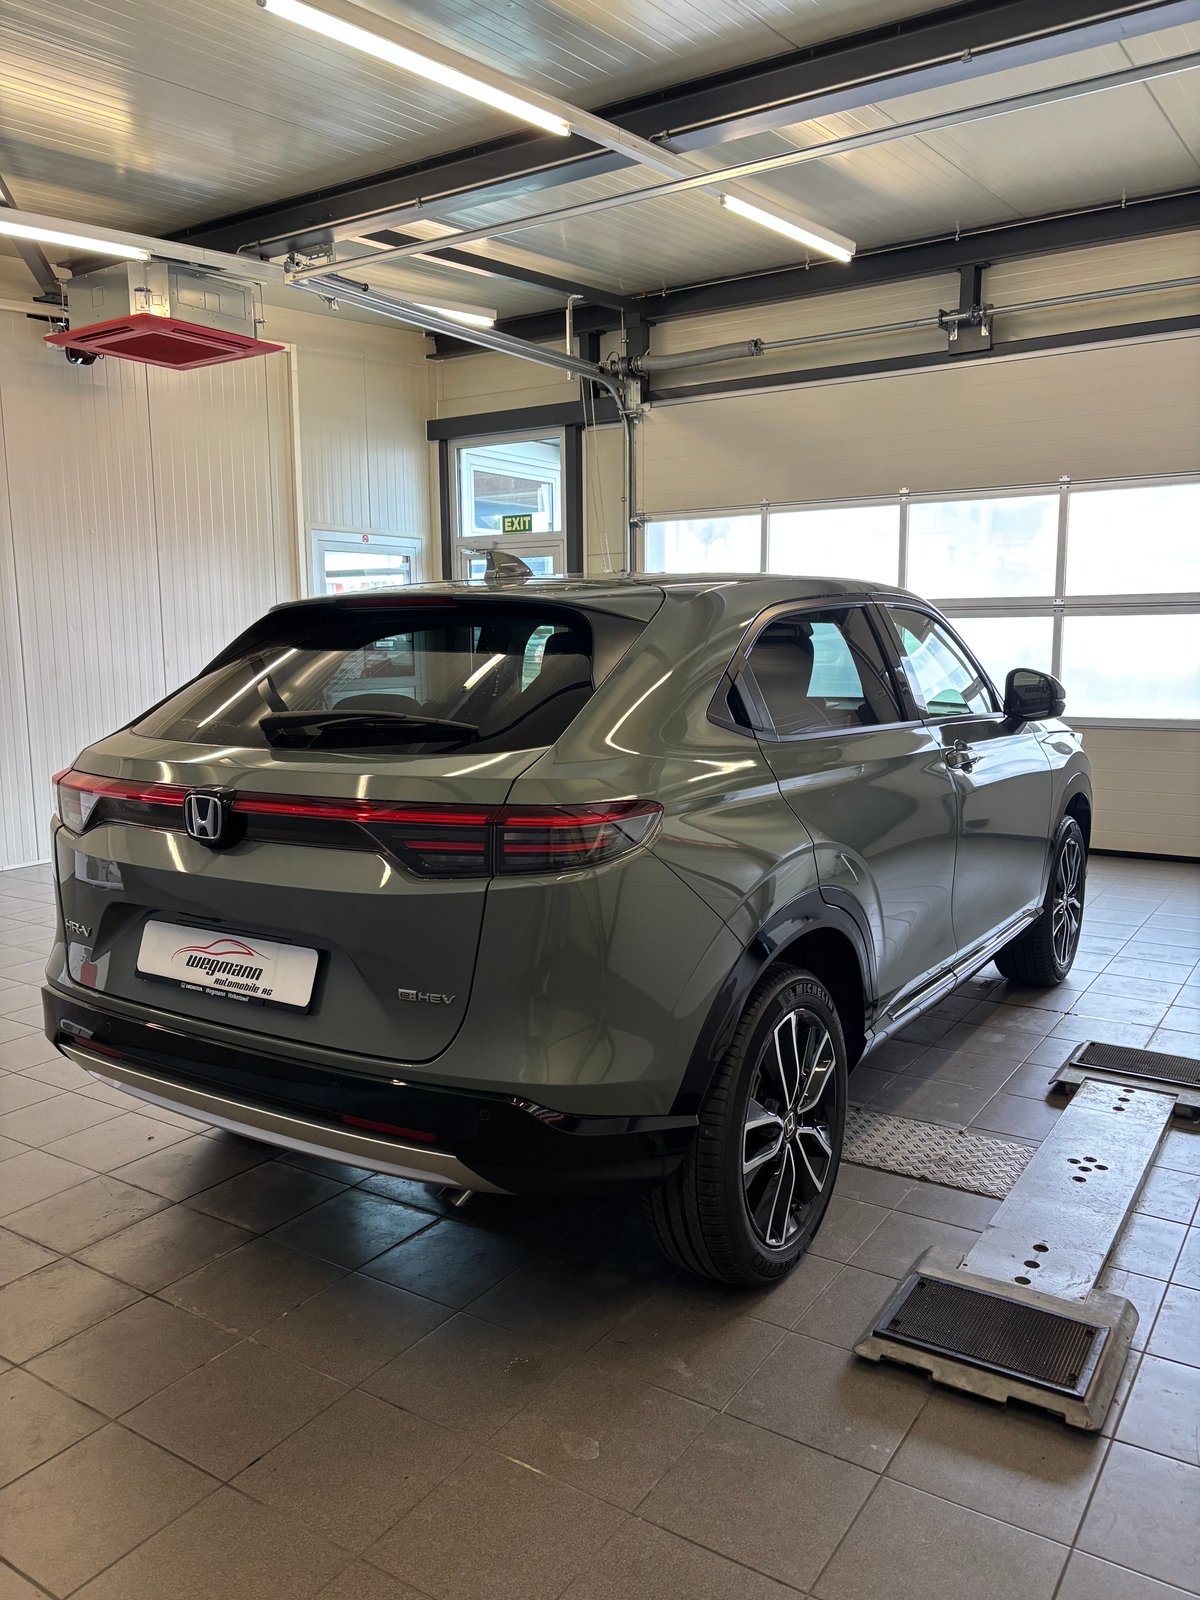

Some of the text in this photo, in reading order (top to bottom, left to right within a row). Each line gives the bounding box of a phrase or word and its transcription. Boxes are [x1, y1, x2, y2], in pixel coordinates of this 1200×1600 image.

[504, 516, 531, 531] EXIT
[65, 918, 92, 937] HR-V
[186, 955, 263, 980] wegmann
[261, 987, 273, 996] AG
[795, 984, 833, 1011] MICHELIN
